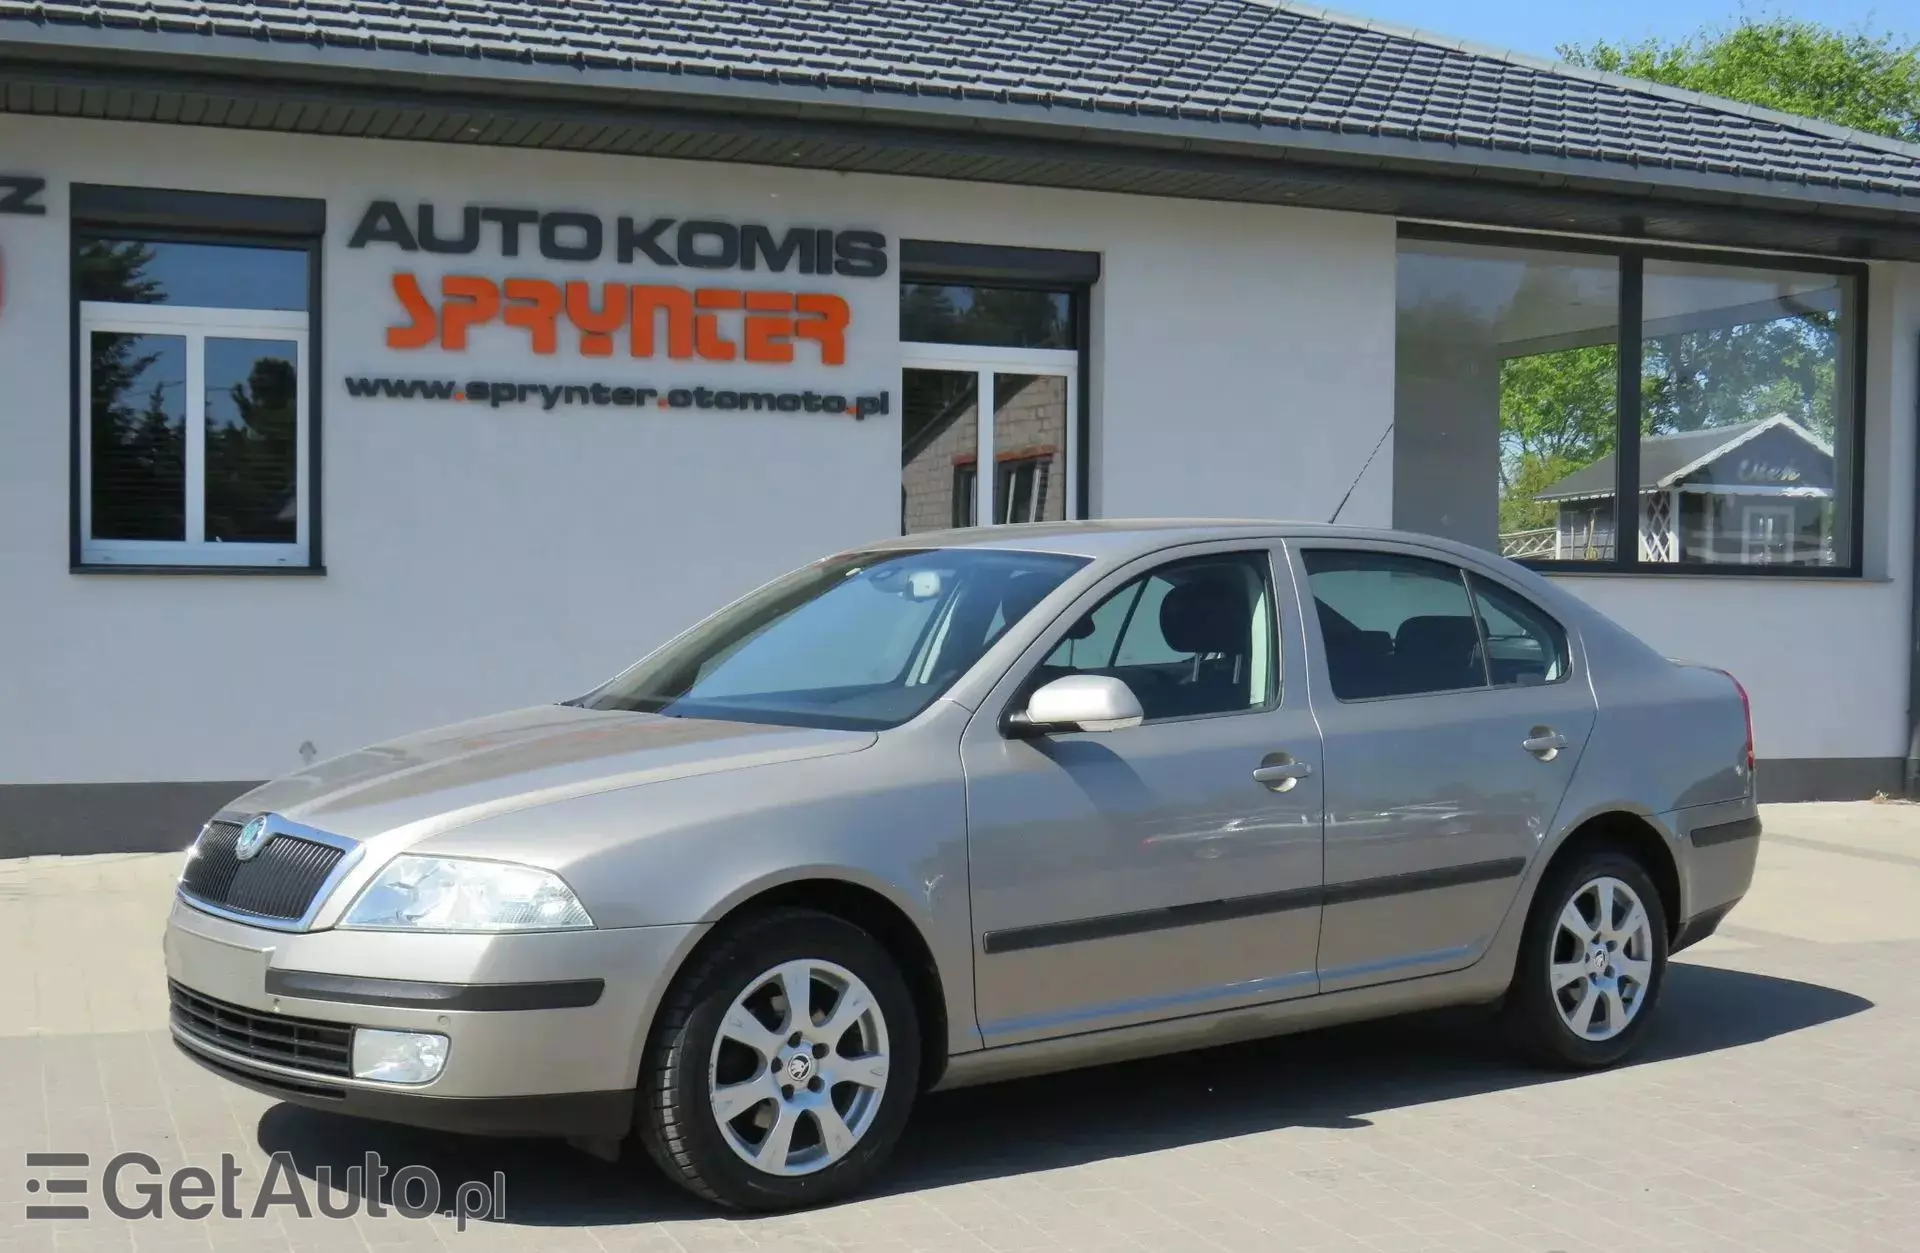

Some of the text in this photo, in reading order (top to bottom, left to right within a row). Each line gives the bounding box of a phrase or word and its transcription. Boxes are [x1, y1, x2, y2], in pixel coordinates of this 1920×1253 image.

[347, 200, 889, 277] AUTO KOMIS
[386, 273, 851, 366] SPRYNTER
[344, 376, 890, 420] www.sprynter.otomoto.pl
